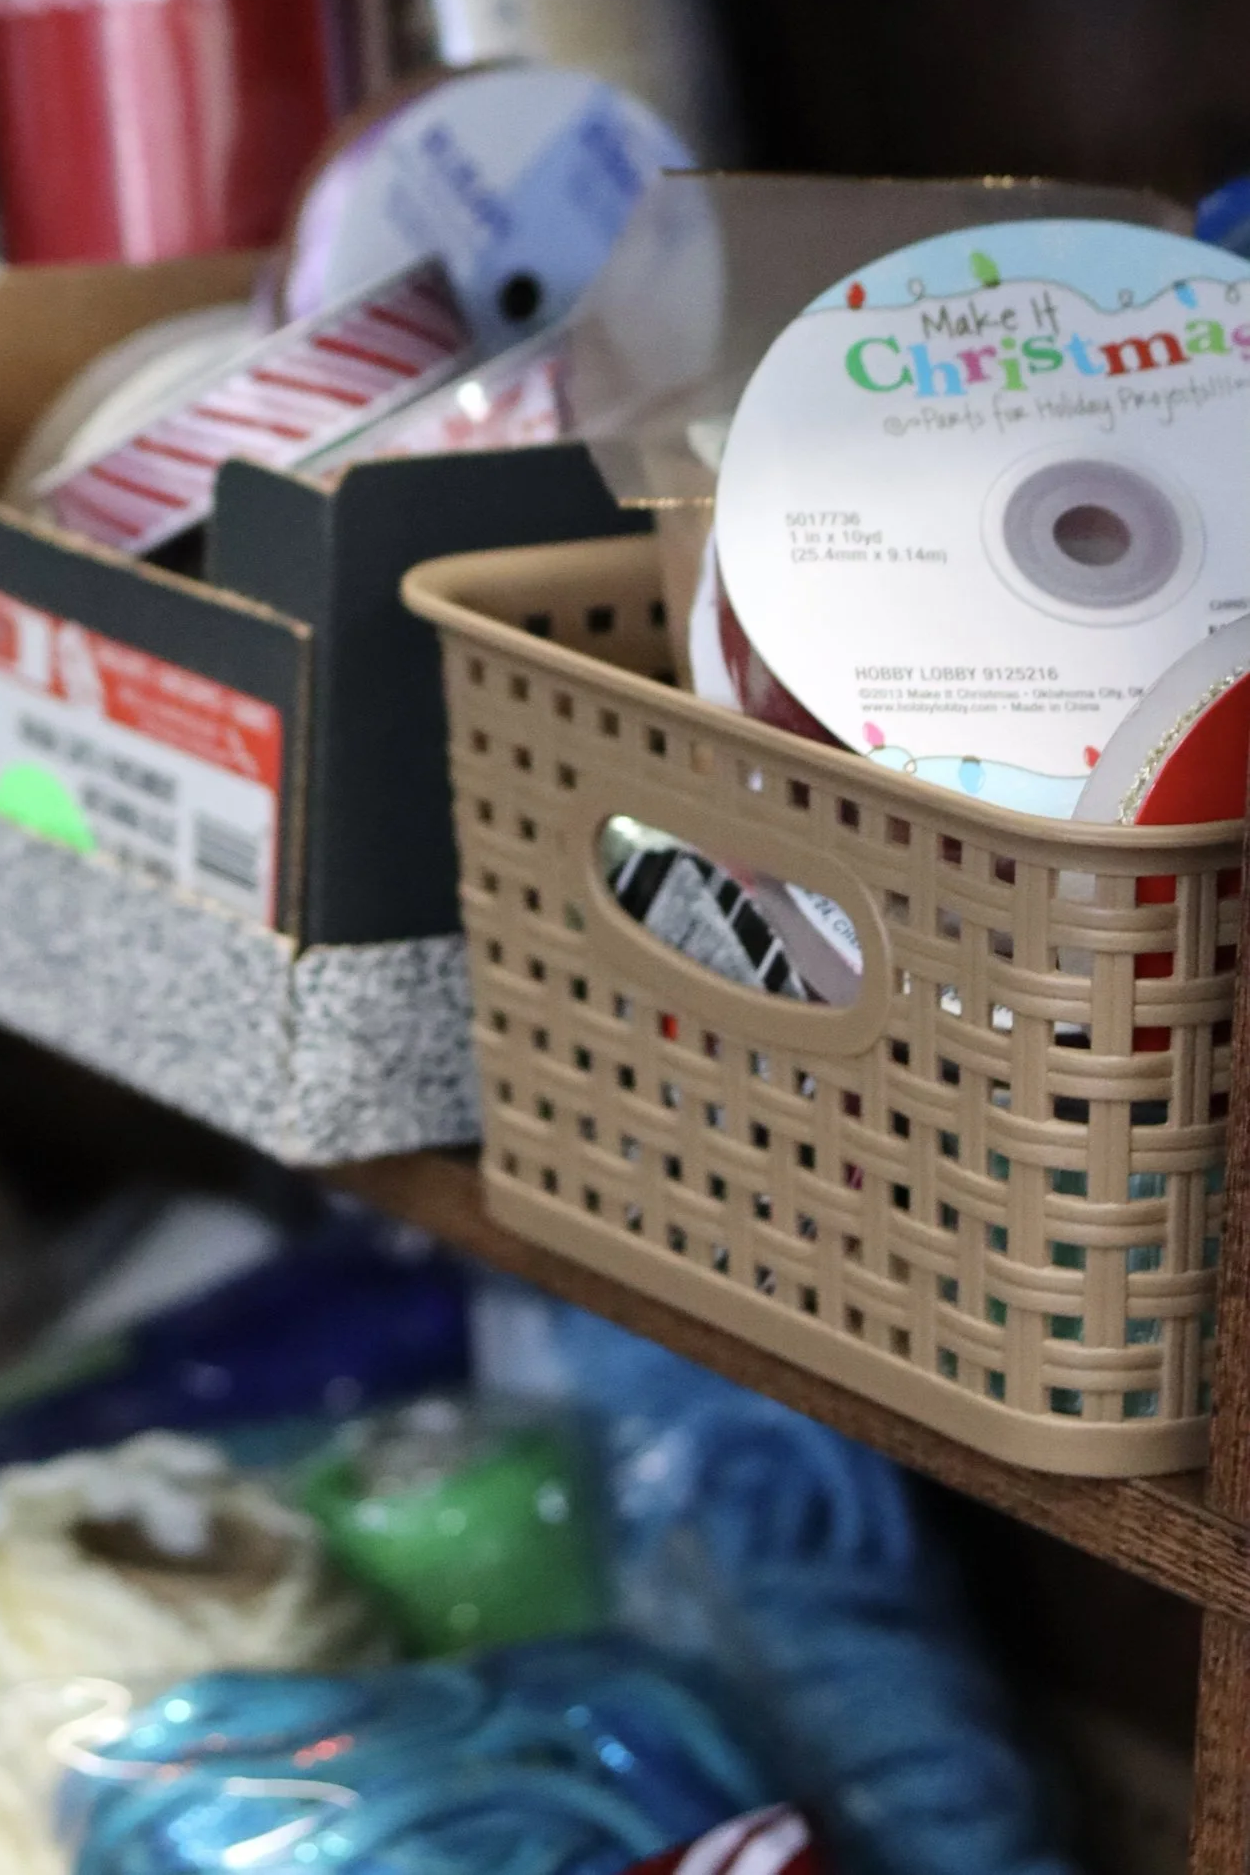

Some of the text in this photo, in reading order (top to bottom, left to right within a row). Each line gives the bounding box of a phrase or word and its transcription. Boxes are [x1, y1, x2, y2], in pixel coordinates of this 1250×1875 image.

[920, 288, 1060, 340] Make It
[1033, 389, 1114, 435] Holiday
[805, 530, 821, 544] in
[842, 528, 883, 546] 10yd
[790, 546, 868, 564] (25.4mm
[887, 546, 948, 565] 9.14m)
[854, 665, 1059, 681] HOBBY LOBBY 9125216
